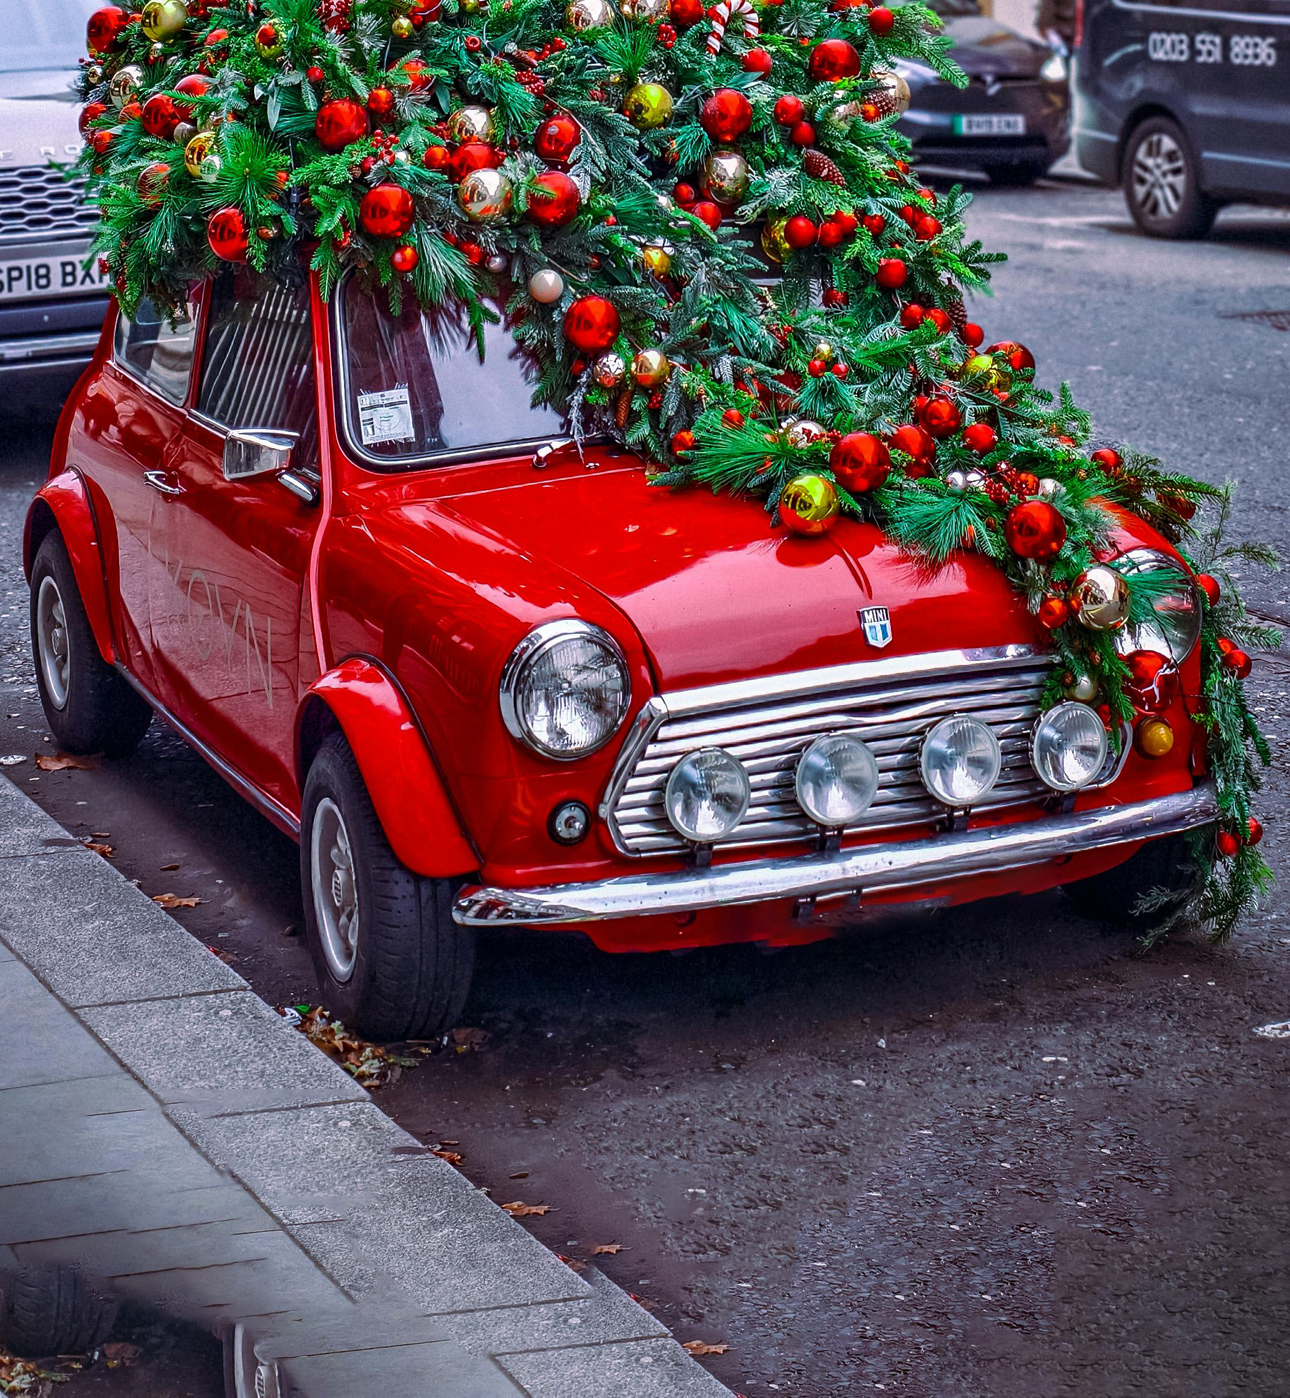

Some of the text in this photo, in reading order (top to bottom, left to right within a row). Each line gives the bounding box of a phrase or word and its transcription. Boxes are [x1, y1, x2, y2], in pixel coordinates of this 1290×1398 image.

[1148, 31, 1190, 61] 0203
[1195, 32, 1222, 63] 551
[0, 263, 52, 294] P18
[864, 608, 887, 623] MINI
